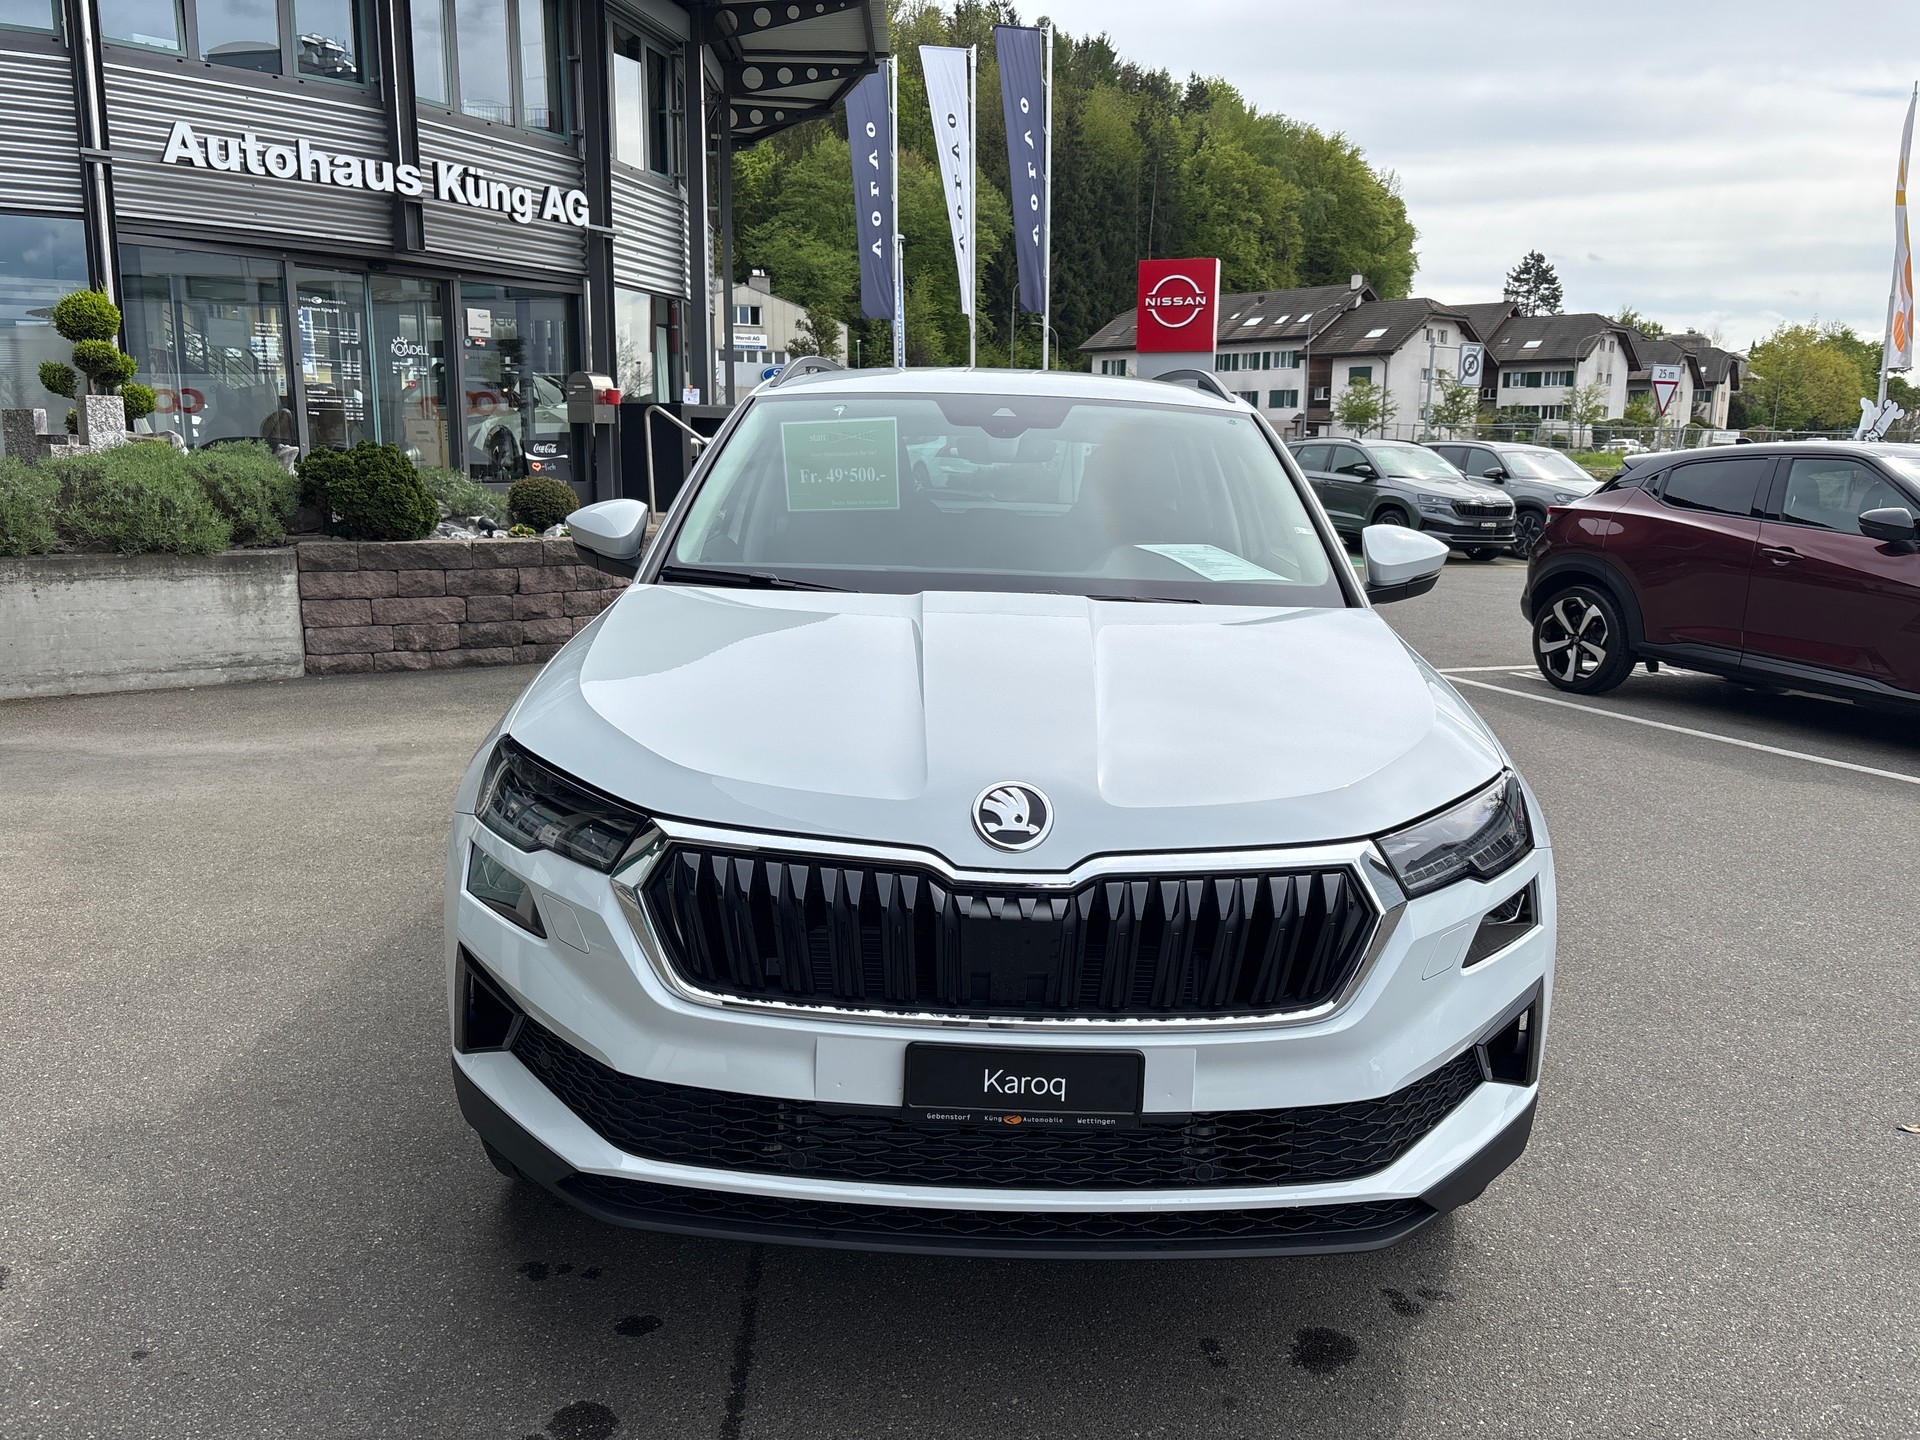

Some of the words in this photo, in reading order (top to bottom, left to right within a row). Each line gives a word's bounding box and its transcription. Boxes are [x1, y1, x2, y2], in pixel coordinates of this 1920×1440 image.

[162, 120, 424, 197] Autohaus
[432, 161, 533, 225] Küng
[538, 185, 590, 227] AG
[1145, 296, 1206, 306] NISSAN
[1659, 368, 1667, 379] 25
[1668, 371, 1675, 379] m
[799, 468, 823, 484] Fr.
[983, 1068, 1066, 1102] Karoq
[926, 1112, 971, 1121] Gebenstorf
[984, 1114, 1002, 1123] Küng
[1022, 1116, 1064, 1124] Automobile
[1077, 1117, 1116, 1126] Wettingen
